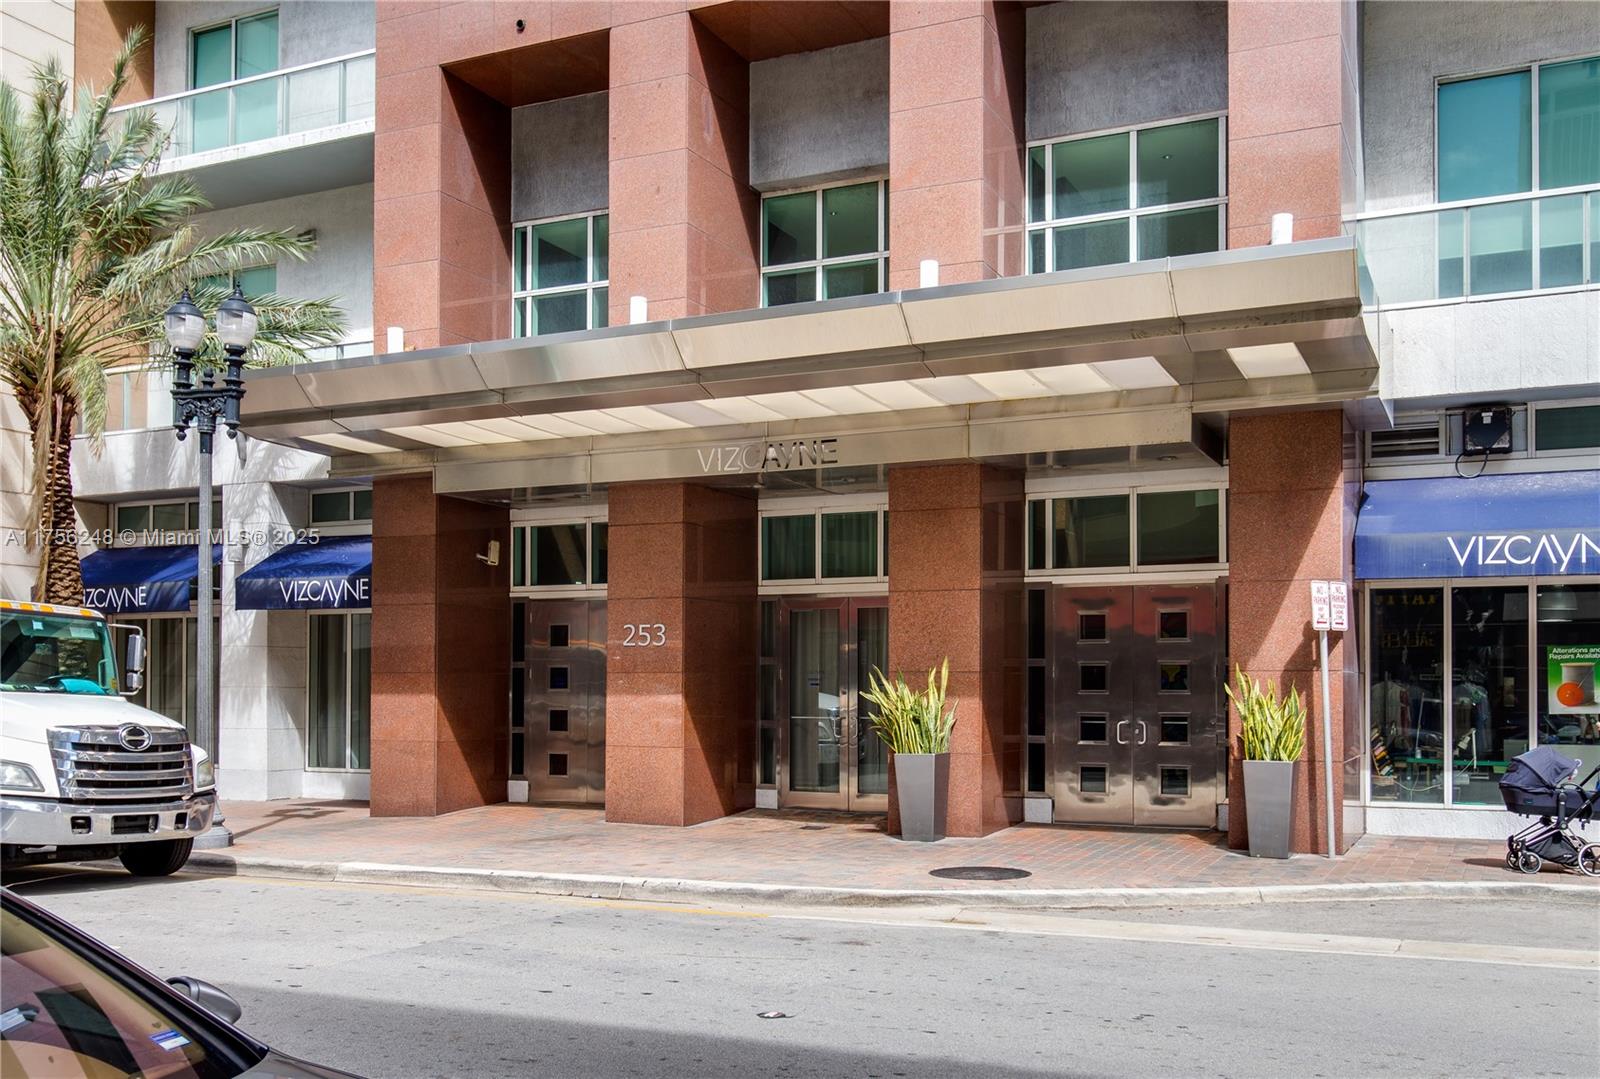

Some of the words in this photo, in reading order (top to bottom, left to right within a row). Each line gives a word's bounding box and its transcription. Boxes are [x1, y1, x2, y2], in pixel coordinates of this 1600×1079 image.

[697, 438, 838, 473] VIZCAYNE
[82, 586, 147, 612] IZCAYNE
[279, 578, 369, 608] VIZCAYNE
[623, 623, 666, 647] 253
